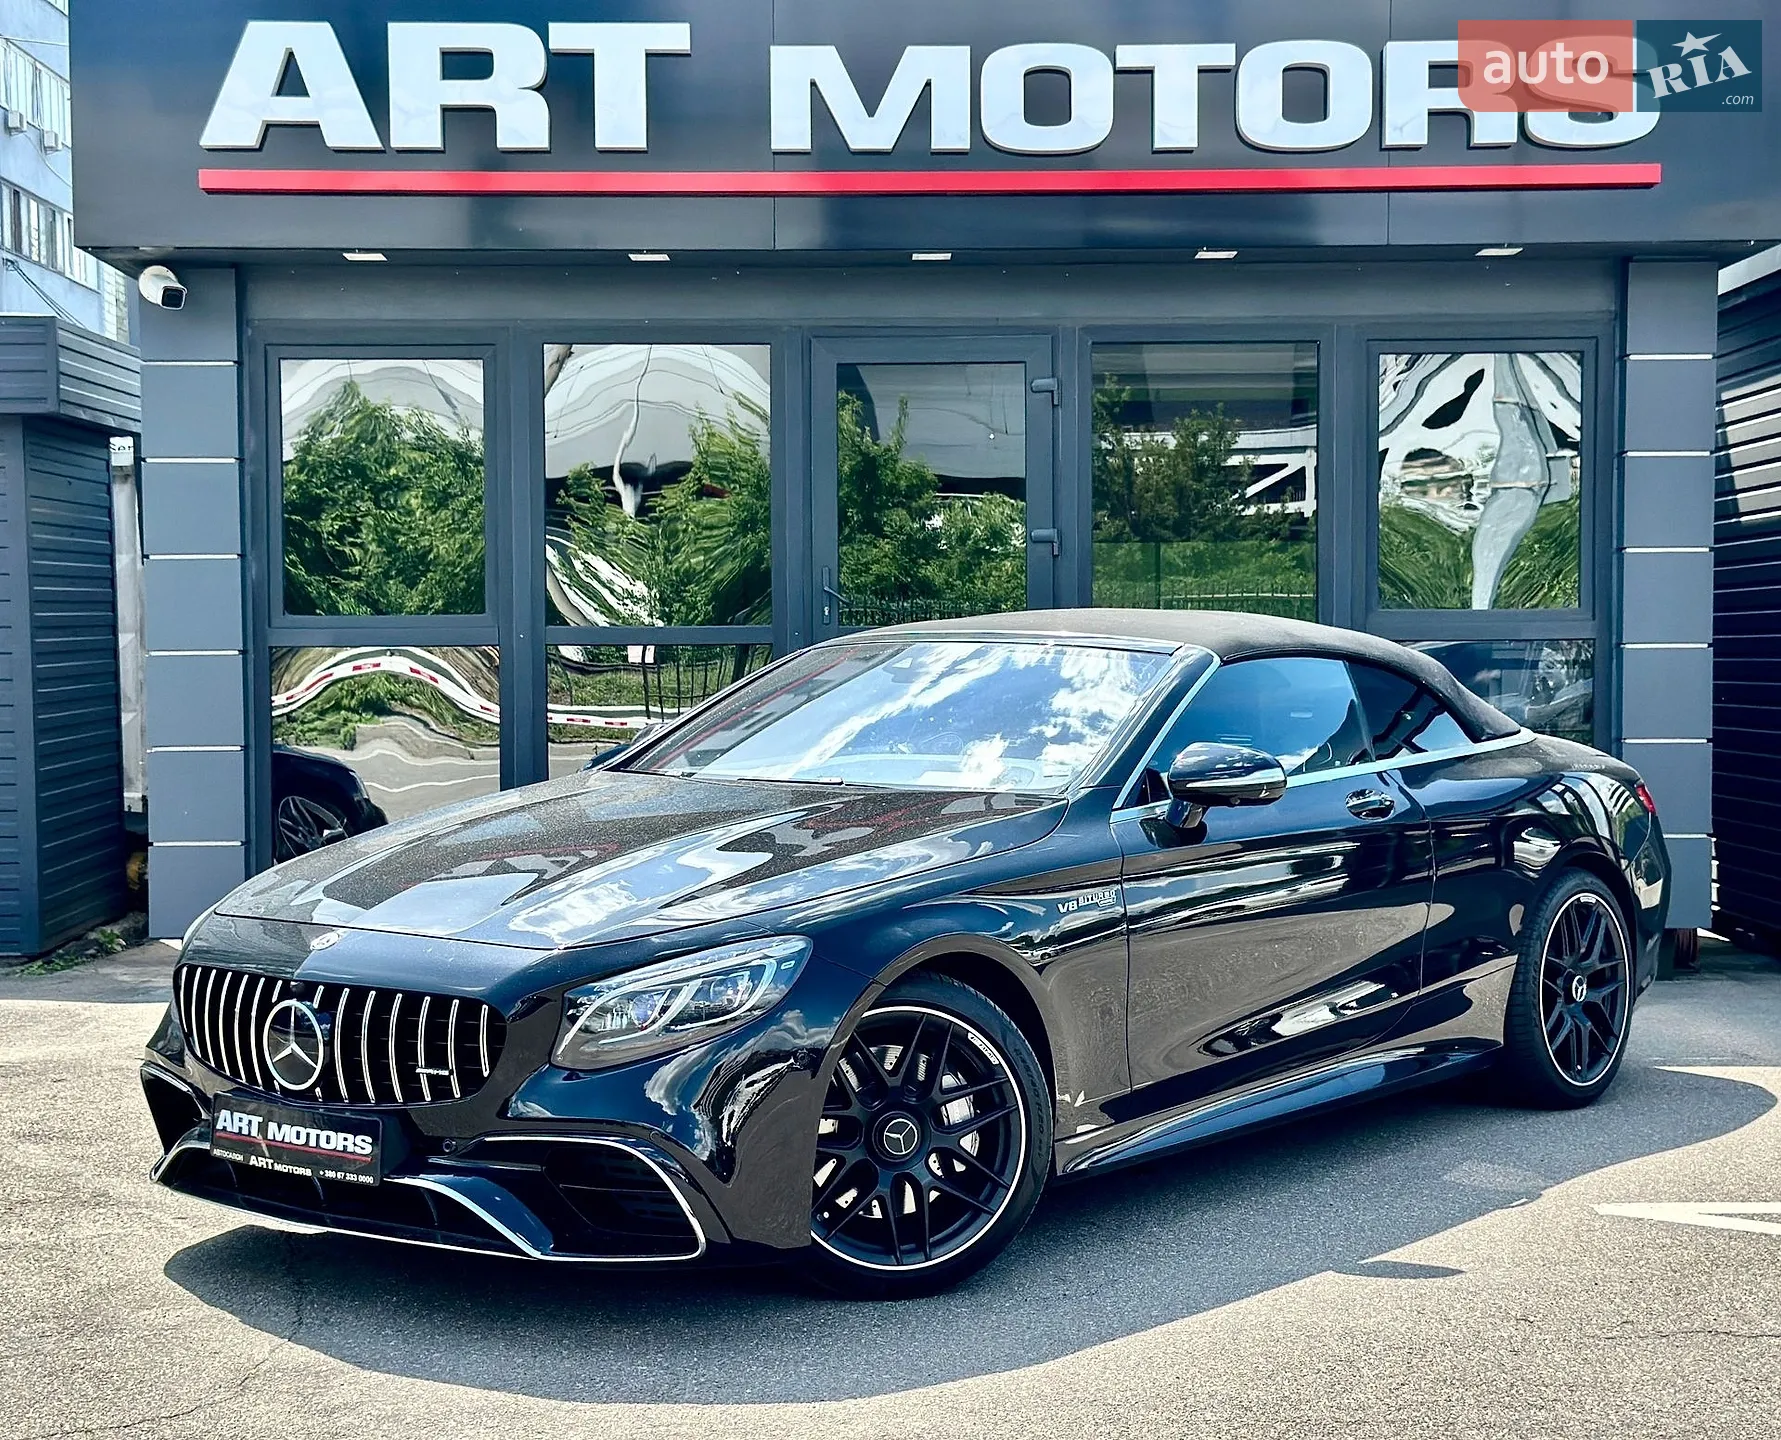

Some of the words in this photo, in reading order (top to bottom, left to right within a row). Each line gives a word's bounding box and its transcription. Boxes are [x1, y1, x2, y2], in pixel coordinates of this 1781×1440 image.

[200, 20, 691, 152] ART
[770, 36, 1661, 153] MOTORS
[1057, 900, 1078, 913] V8
[215, 1109, 263, 1137] ART
[267, 1121, 373, 1155] MOTORS
[249, 1155, 274, 1169] ART
[273, 1162, 312, 1177] MOTORS
